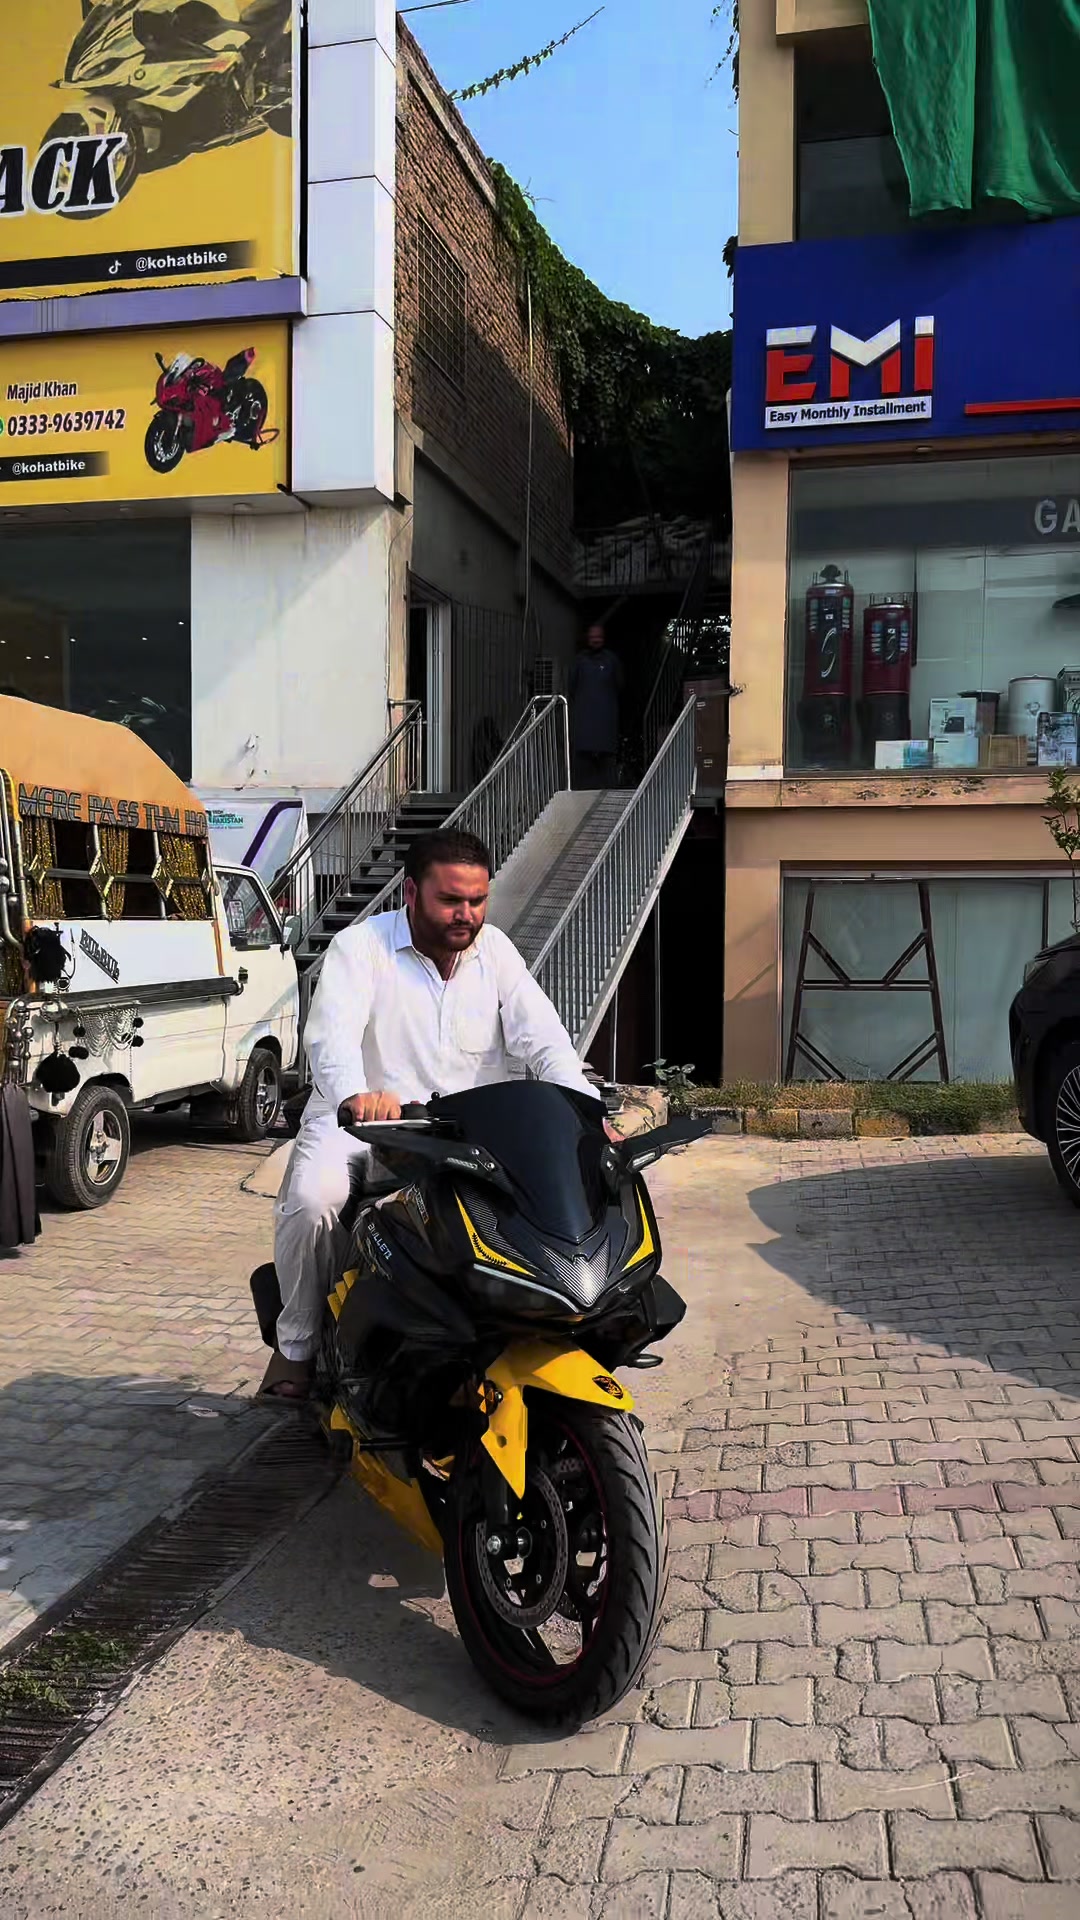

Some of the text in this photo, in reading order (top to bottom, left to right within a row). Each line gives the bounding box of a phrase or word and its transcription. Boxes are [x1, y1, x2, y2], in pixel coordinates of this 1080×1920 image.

[135, 251, 228, 272] @kohatbike
[765, 315, 934, 402] EMI
[7, 381, 77, 404] Majid Khan
[7, 408, 125, 436] 0333-9639742
[769, 401, 926, 423] Easy Monthly Installment
[12, 459, 86, 475] @kohatbike
[18, 783, 81, 821] MERE
[88, 794, 139, 828] PASS
